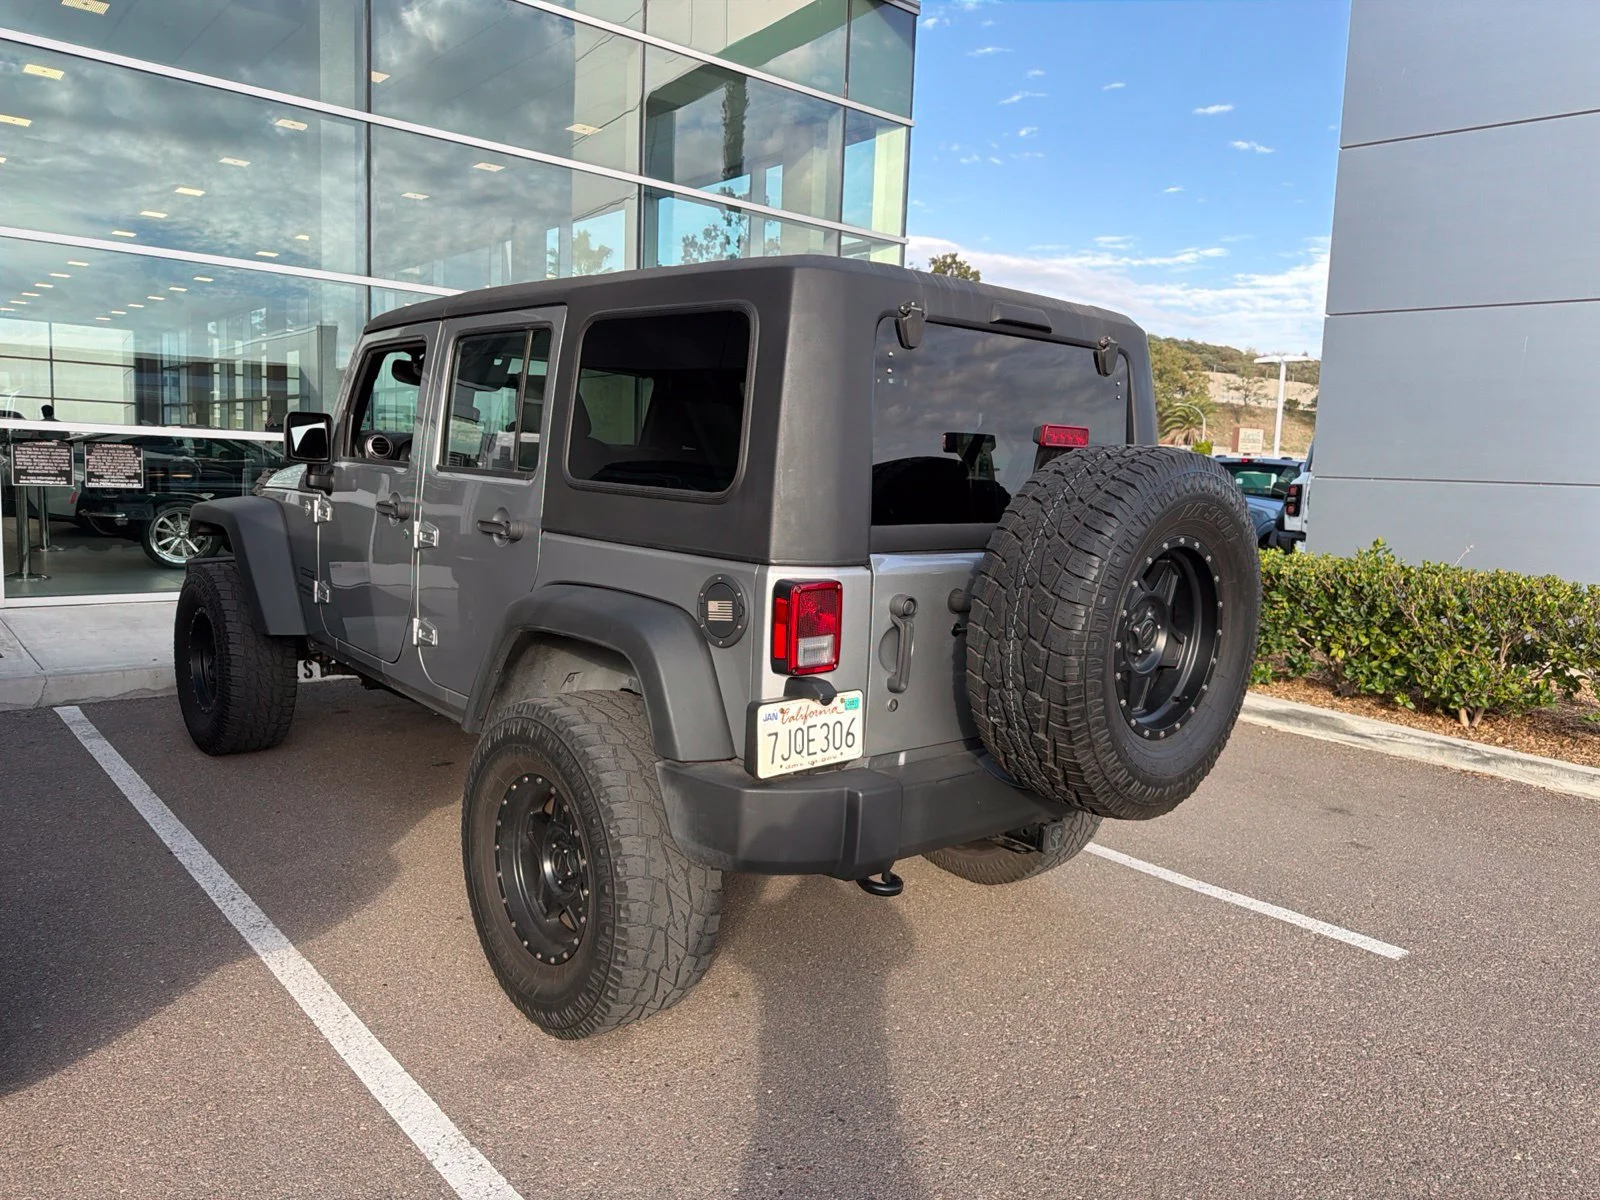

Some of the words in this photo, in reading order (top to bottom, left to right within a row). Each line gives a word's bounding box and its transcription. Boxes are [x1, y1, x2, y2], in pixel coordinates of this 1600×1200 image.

[763, 713, 778, 722] JAN
[781, 705, 844, 725] California
[767, 718, 856, 765] 7JQE306
